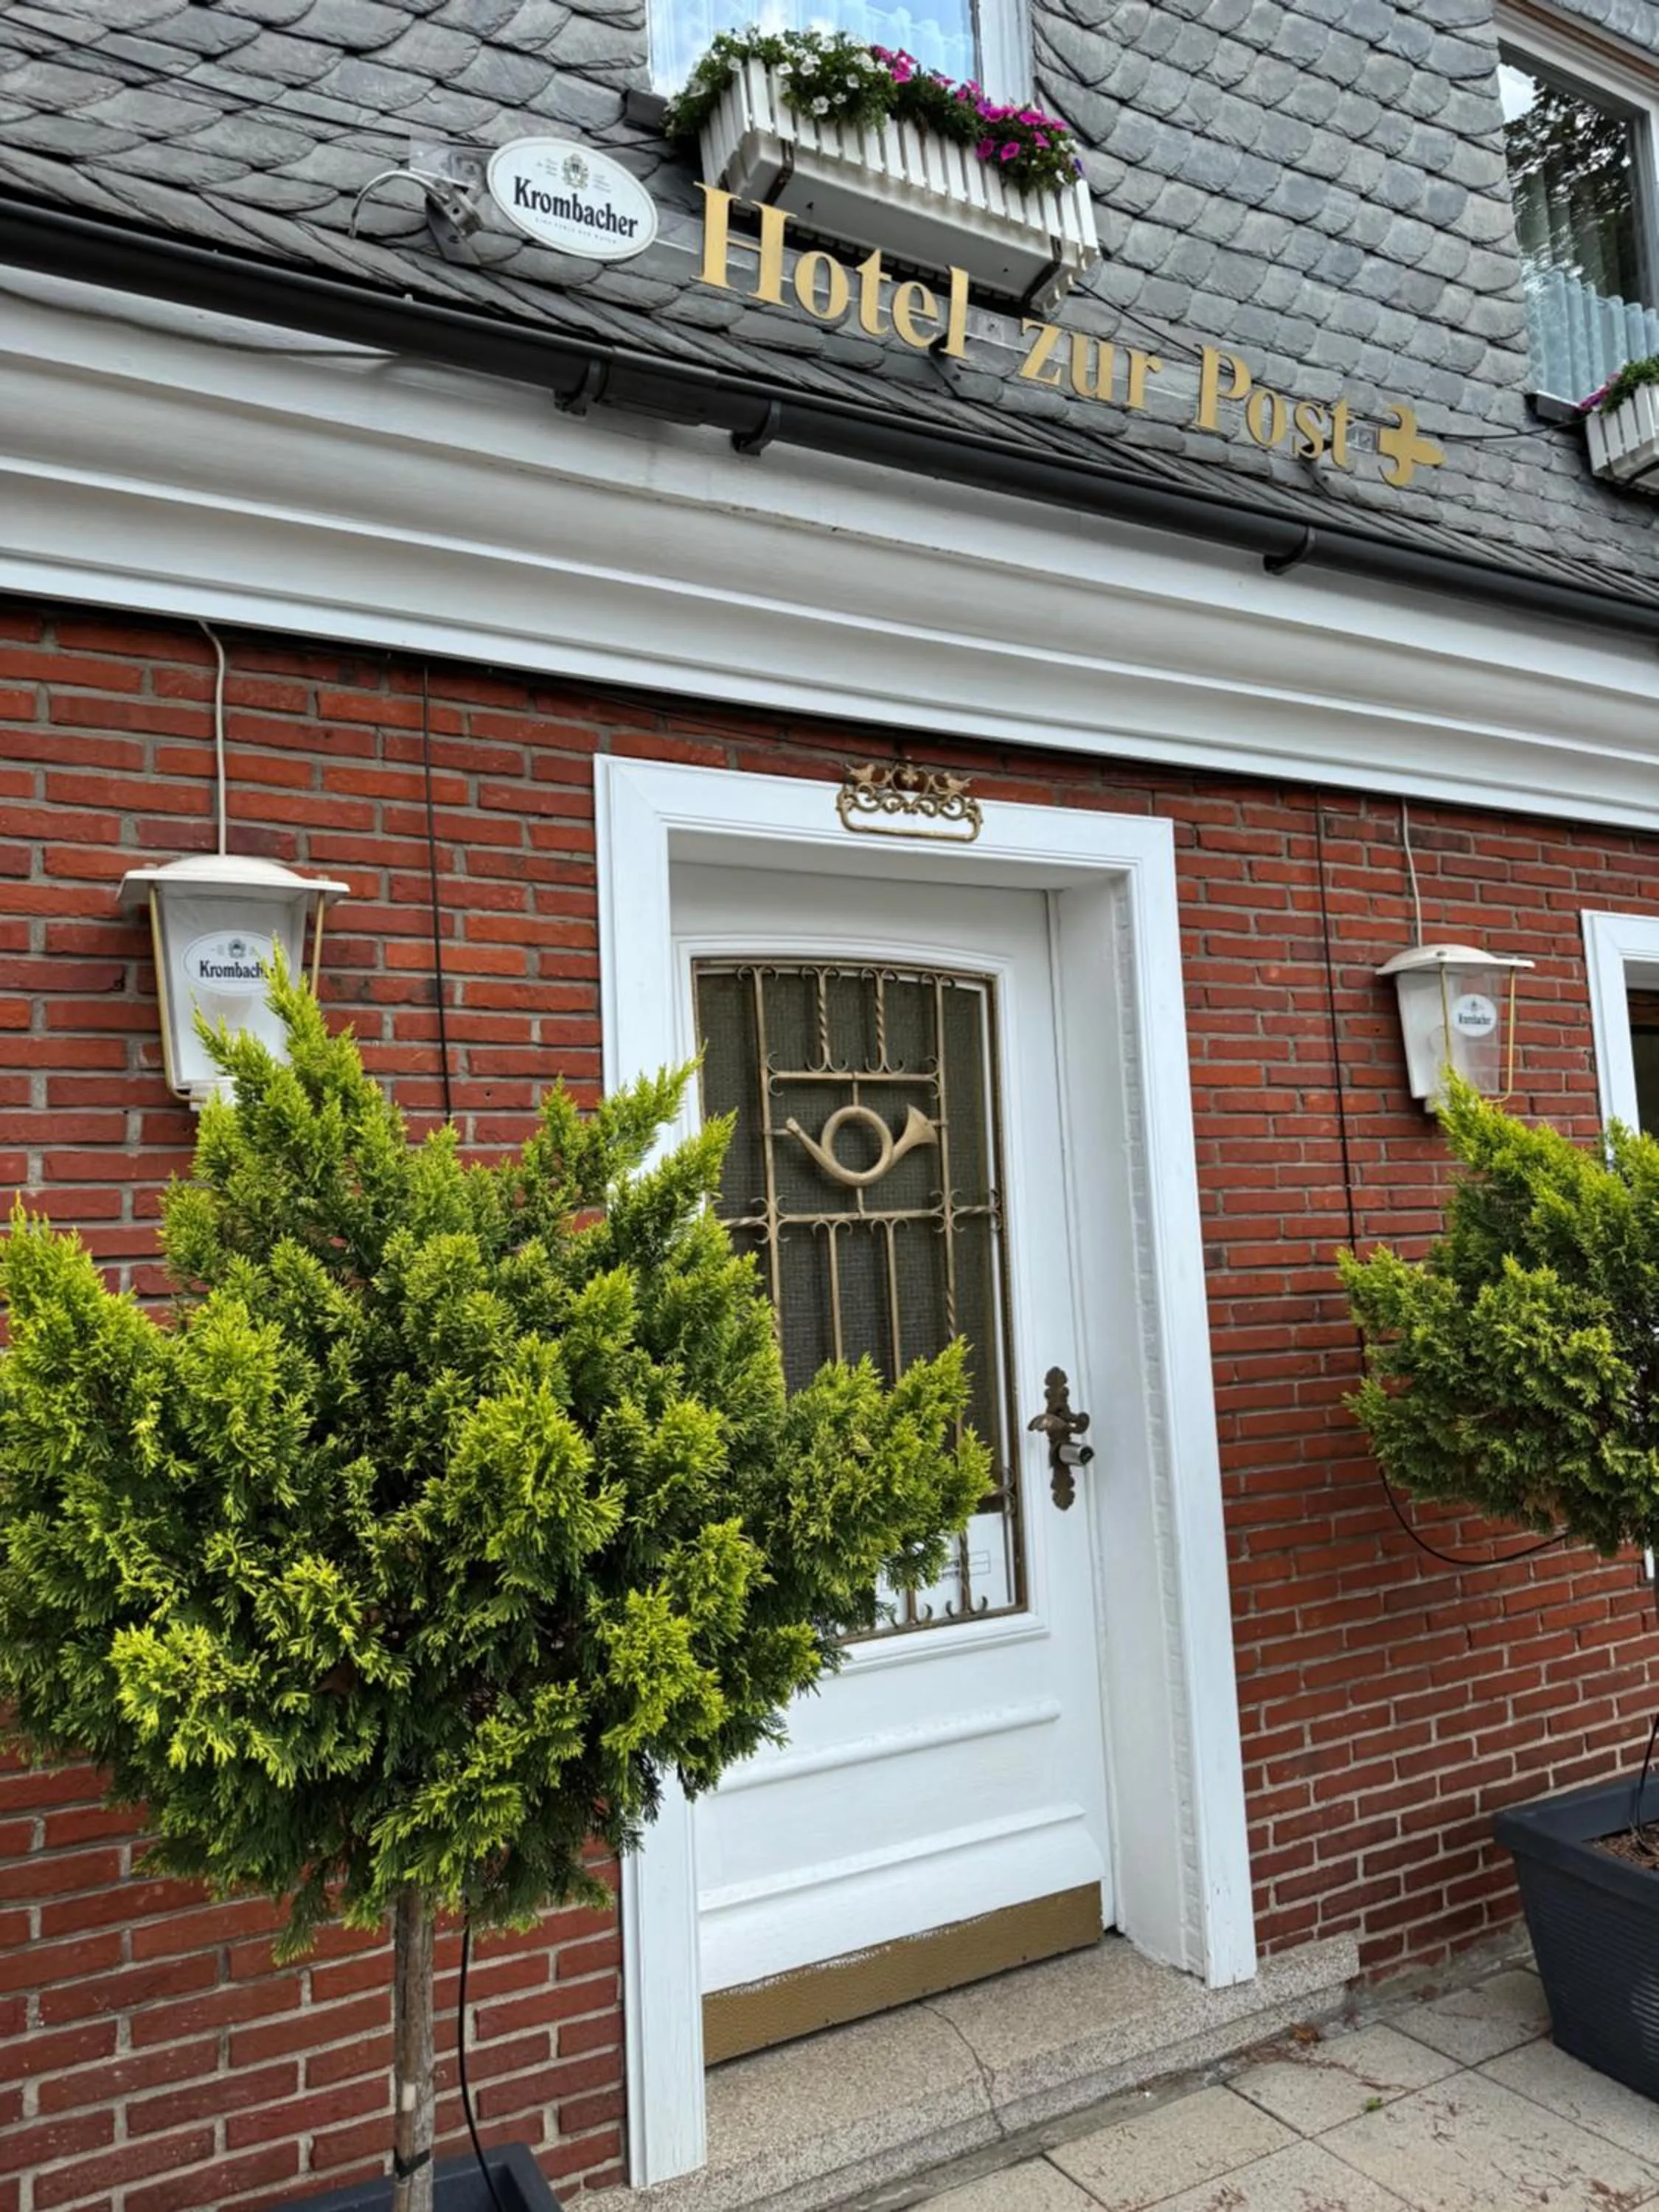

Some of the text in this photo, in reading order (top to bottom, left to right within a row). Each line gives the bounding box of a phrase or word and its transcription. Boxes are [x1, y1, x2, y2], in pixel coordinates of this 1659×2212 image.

[513, 175, 638, 238] Krombacher
[689, 181, 1356, 472] Hotel zur Post
[200, 960, 276, 979] Krombach
